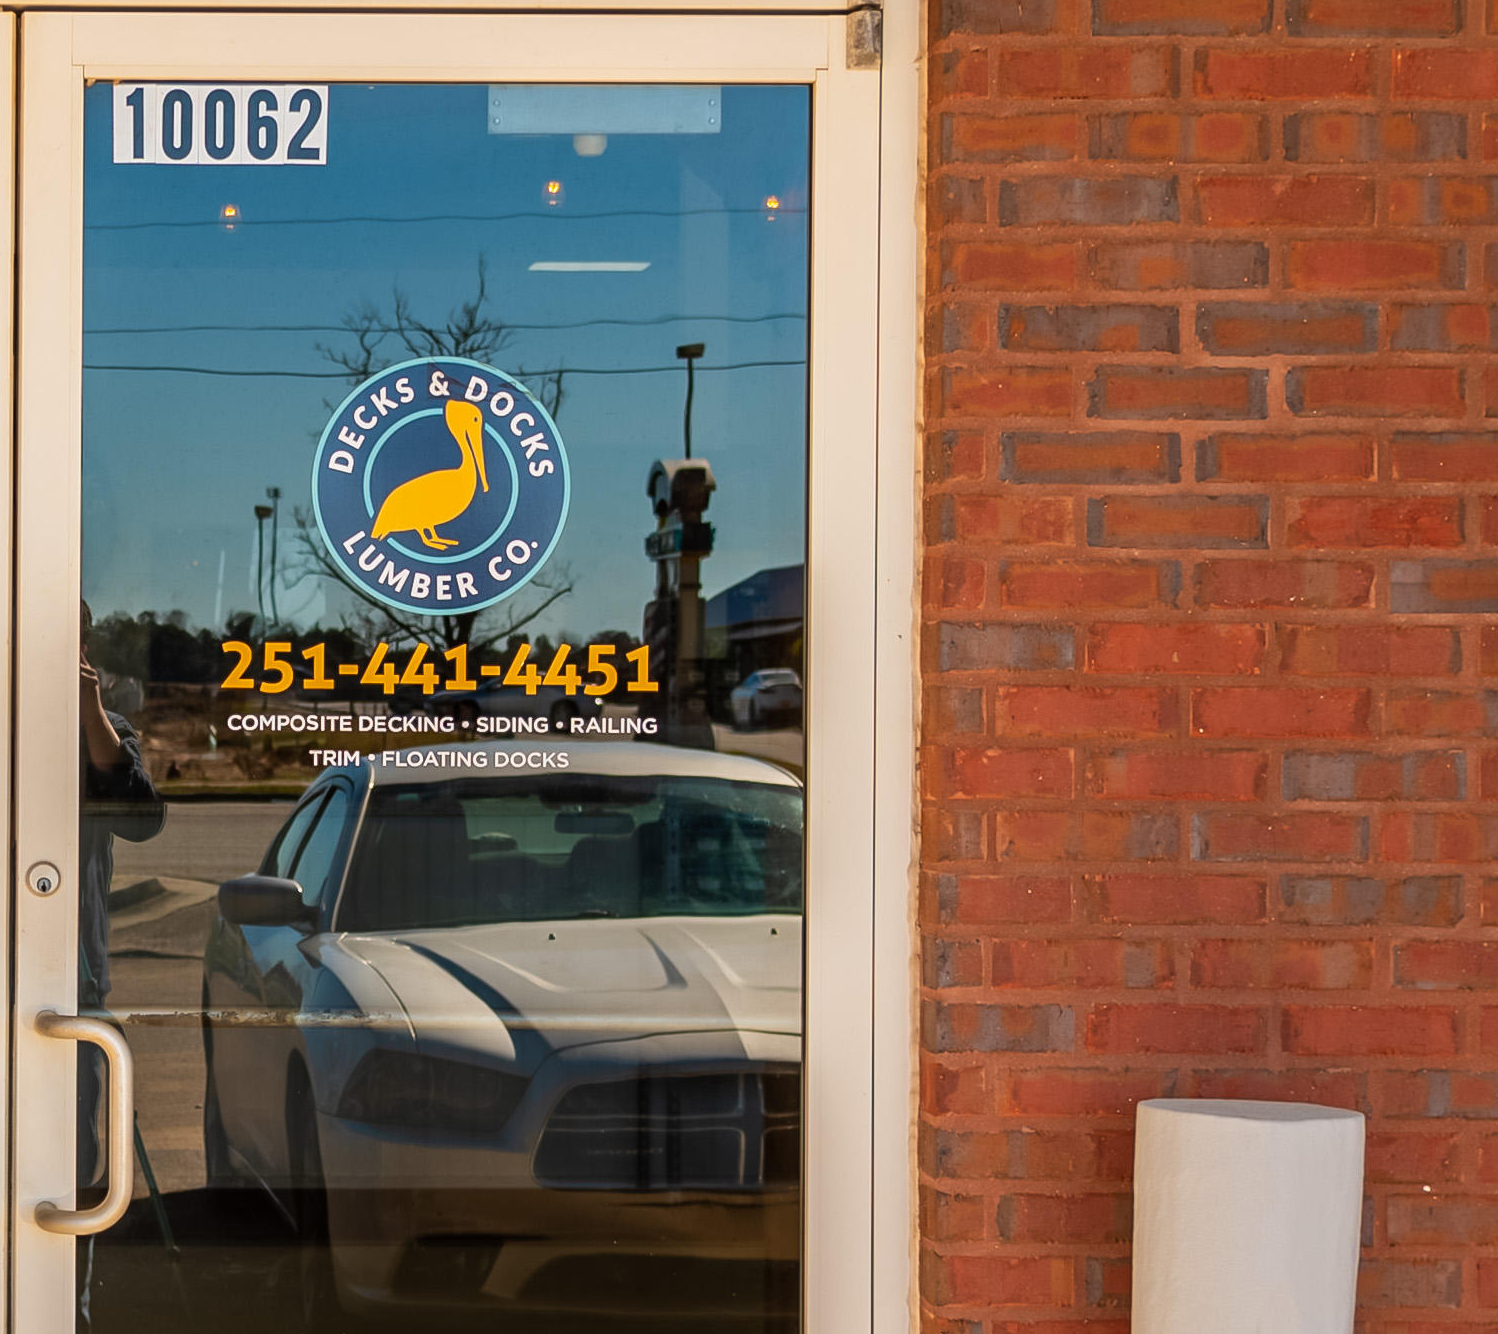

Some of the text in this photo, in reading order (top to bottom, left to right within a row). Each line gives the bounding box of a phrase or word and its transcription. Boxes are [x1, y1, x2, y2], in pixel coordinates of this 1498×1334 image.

[125, 87, 323, 161] 10062
[328, 370, 555, 478] DECKS & DOCKS
[342, 530, 539, 601] LUMBER CO.
[220, 640, 660, 696] 251-441-4451
[226, 714, 658, 735] COMPOSITE DECKING SIDING RAILING
[308, 749, 570, 769] TRIM FLOATING DOCKS
